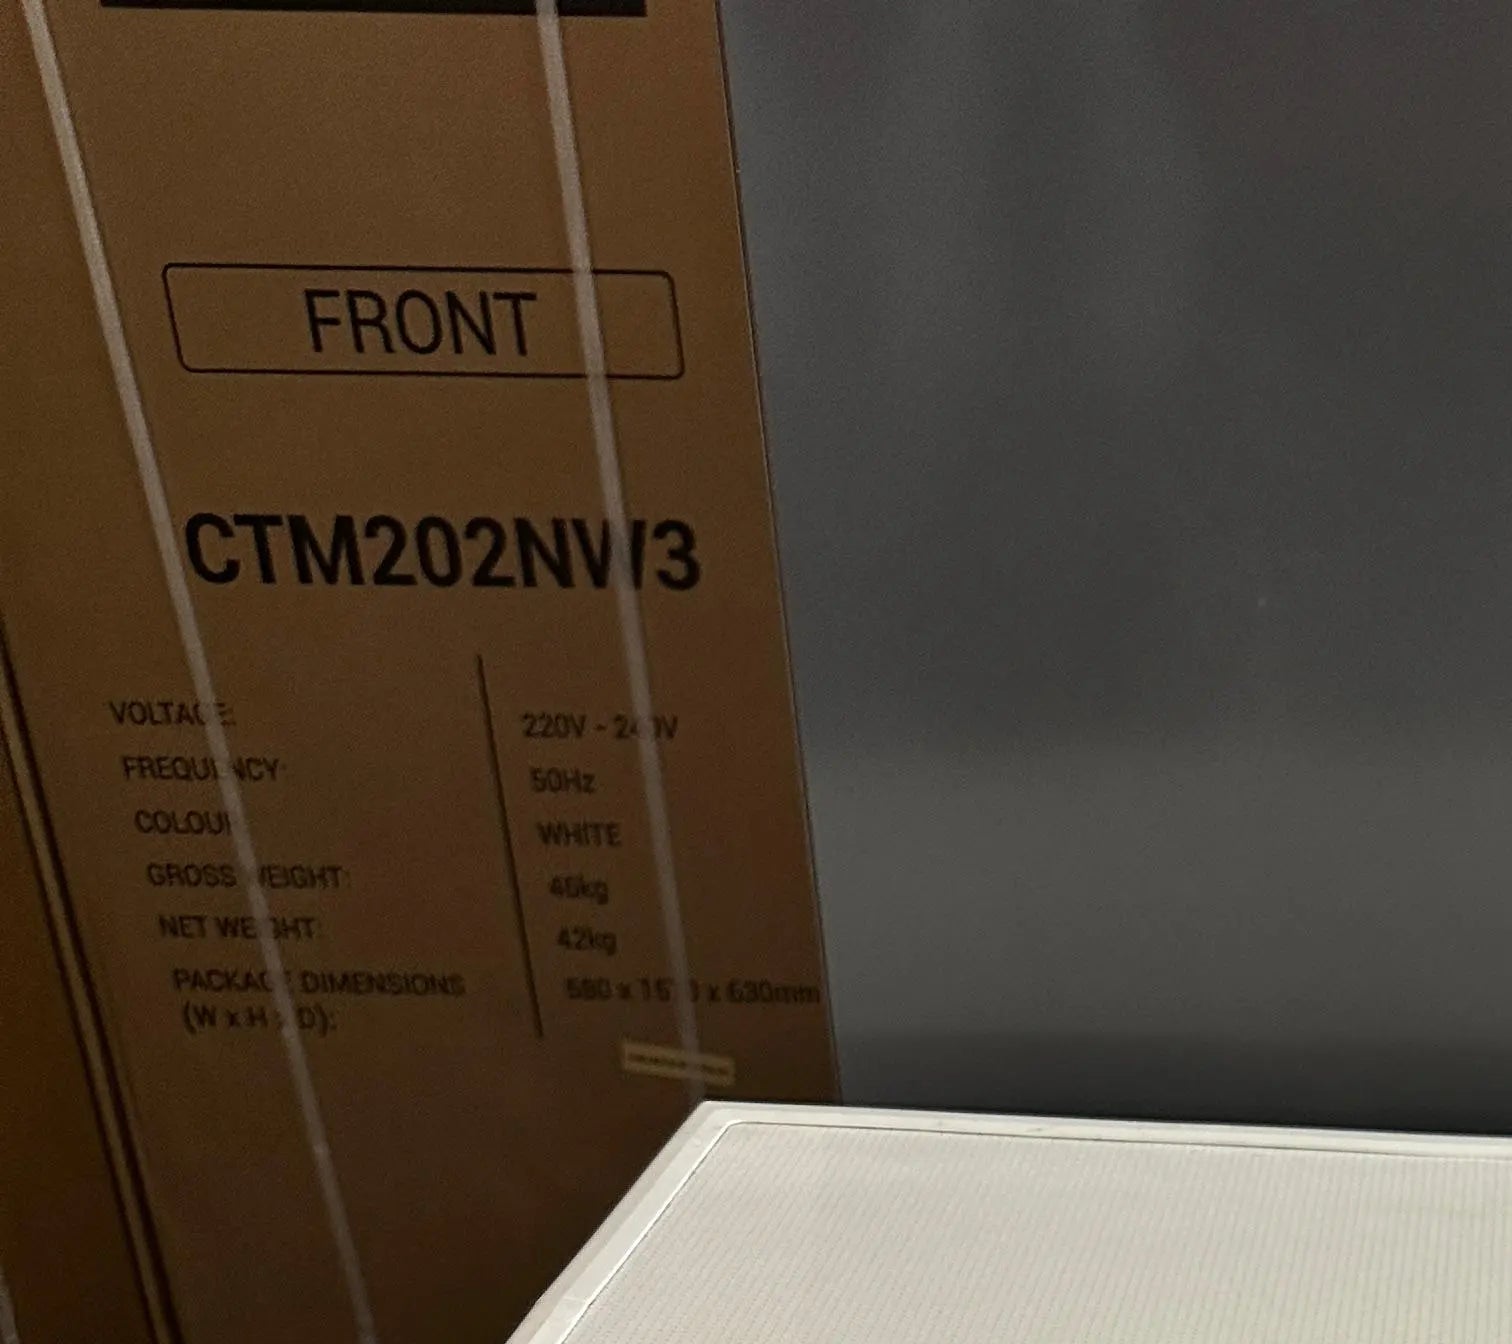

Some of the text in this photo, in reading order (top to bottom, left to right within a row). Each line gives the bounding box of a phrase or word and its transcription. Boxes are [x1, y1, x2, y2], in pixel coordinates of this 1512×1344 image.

[304, 288, 537, 356] FRONT
[185, 513, 701, 590] CTM202NW3
[522, 714, 587, 738] 220V
[122, 756, 286, 781] FREQUNCY:
[530, 767, 596, 793] 50Hz
[134, 809, 238, 835] COLOU
[537, 821, 622, 847] WHITE
[146, 862, 237, 888] GROSS
[158, 914, 207, 939] NET
[300, 970, 466, 996] DIMENSIONS
[246, 1006, 267, 1028] H
